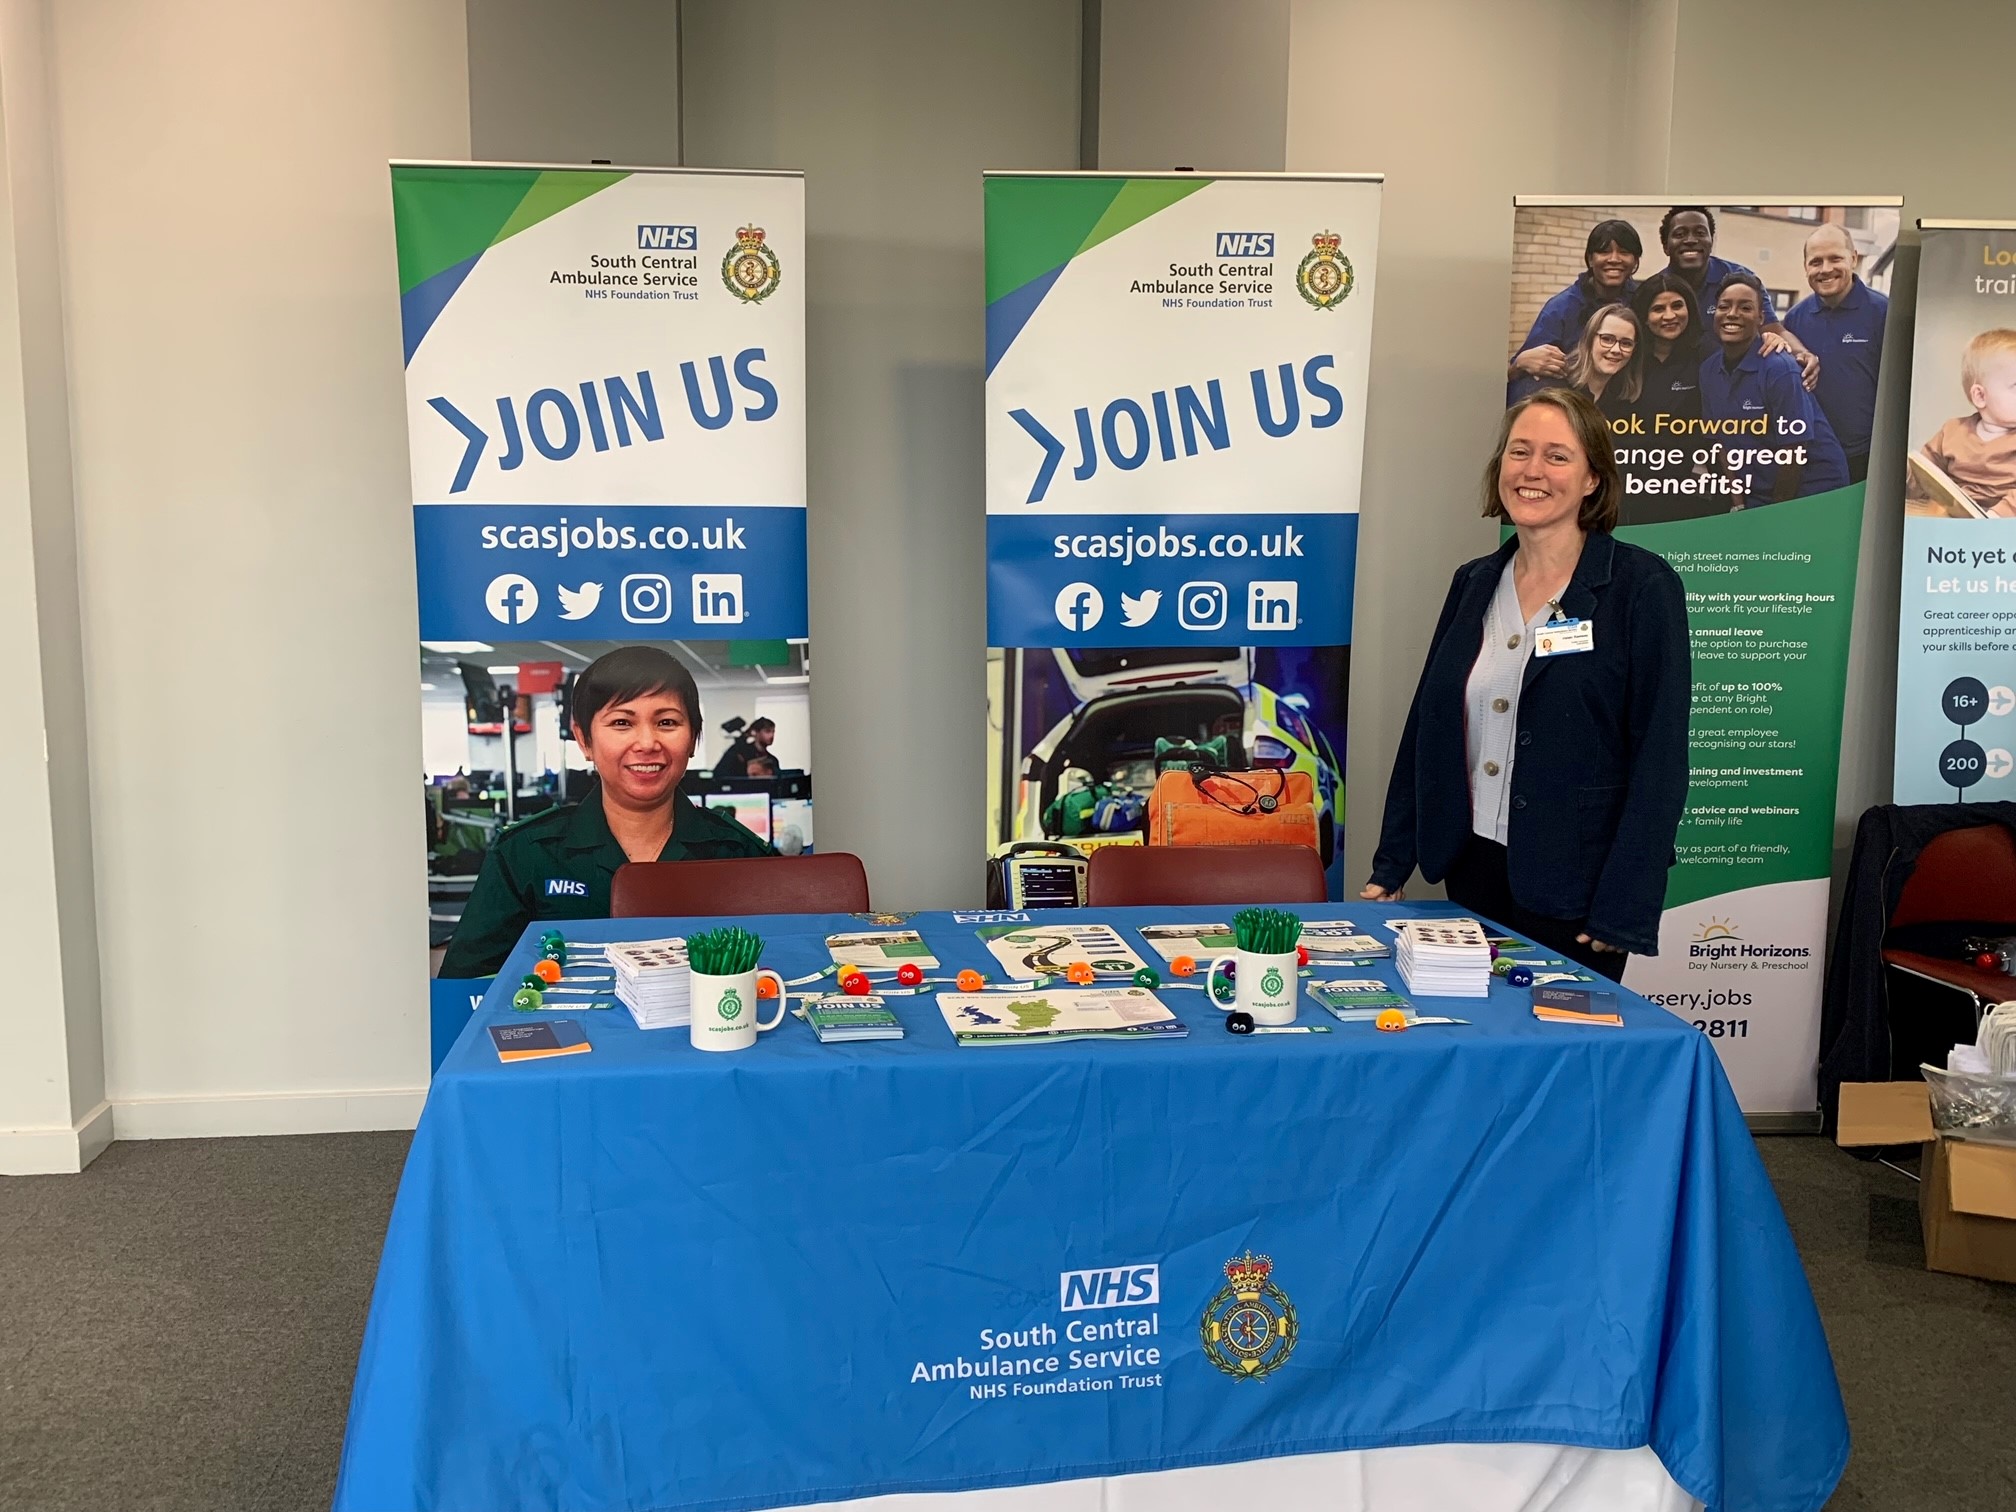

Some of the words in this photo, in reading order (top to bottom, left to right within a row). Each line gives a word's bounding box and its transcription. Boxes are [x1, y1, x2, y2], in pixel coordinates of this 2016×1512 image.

[640, 226, 695, 249] NHS
[1217, 234, 1272, 257] NHS
[591, 255, 636, 269] South
[642, 255, 697, 270] Central
[1169, 263, 1213, 277] South
[1218, 263, 1273, 277] Central
[550, 271, 638, 286] Ambulance
[643, 272, 698, 287] Service
[1975, 275, 2016, 294] trai
[1130, 280, 1214, 294] Ambulance
[1219, 280, 1273, 294] Service
[585, 290, 608, 299] NHS
[611, 290, 670, 300] Foundation
[673, 291, 698, 300] Trust
[1162, 298, 1184, 308] NHS
[1186, 298, 1245, 308] Foundation
[1248, 299, 1273, 308] Trust
[496, 370, 665, 471] JOIN
[680, 348, 779, 431] US
[1073, 378, 1231, 481] JOIN
[1250, 355, 1343, 438] US
[1605, 413, 1645, 434] ok
[1654, 413, 1768, 435] Forward
[1777, 415, 1807, 435] to
[1614, 448, 1684, 471] ange
[1692, 443, 1722, 465] of
[1726, 444, 1807, 471] great
[1625, 473, 1752, 495] benefits!
[481, 518, 747, 557] scasjobs.co.uk
[1054, 526, 1304, 566] scasjobs.co.uk
[1667, 552, 1690, 562] high
[1693, 552, 1723, 561] street
[1725, 553, 1760, 561] names
[1762, 552, 1811, 563] including
[1928, 546, 1966, 564] Not
[1971, 548, 2006, 568] yet
[1673, 564, 1694, 572] and
[1697, 564, 1739, 574] holidays
[1926, 576, 1960, 593] Let
[1966, 580, 1989, 593] us
[1995, 576, 2016, 593] he
[1686, 592, 1706, 603] ility
[1708, 592, 1731, 601] with
[1733, 594, 1757, 604] your
[1759, 592, 1803, 603] working
[1805, 593, 1835, 602] hours
[1706, 605, 1731, 613] work
[1733, 605, 1745, 613] fit
[1746, 606, 1769, 615] your
[1772, 605, 1813, 615] lifestyle
[1924, 610, 1955, 620] Great
[1957, 612, 1990, 620] career
[1695, 628, 1732, 636] annual
[1734, 628, 1764, 636] leave
[1923, 625, 2002, 637] apprenticeship
[1690, 640, 1708, 648] the
[1710, 639, 1743, 649] option
[1745, 640, 1757, 648] to
[1759, 640, 1808, 650] purchase
[1922, 643, 1947, 654] your
[1948, 642, 1972, 651] skills
[1974, 641, 2010, 651] before
[1697, 651, 1725, 659] leave
[1740, 652, 1781, 662] support
[1783, 653, 1807, 662] your
[1691, 682, 1706, 691] efit
[1709, 682, 1721, 691] of
[1721, 684, 1735, 693] up
[1737, 683, 1749, 691] to
[1752, 683, 1783, 691] 100%
[1701, 694, 1712, 702] at
[1714, 695, 1733, 704] any
[1736, 694, 1767, 705] Bright
[1953, 695, 1978, 708] 16+
[1690, 705, 1732, 715] pendent
[1750, 705, 1773, 715] role)
[1698, 728, 1726, 739] great
[1728, 728, 1779, 739] employee
[1689, 739, 1746, 750] recognising
[1768, 740, 1796, 748] stars!
[1947, 757, 1979, 771] 200
[1720, 767, 1741, 775] and
[1743, 767, 1803, 776] investment
[1689, 779, 1749, 788] evelopment
[1691, 806, 1726, 814] advice
[1728, 806, 1749, 814] and
[1751, 806, 1800, 815] webinars
[1695, 816, 1726, 827] family
[1728, 816, 1743, 825] life
[1704, 845, 1726, 855] part
[1728, 844, 1739, 853] of
[1750, 844, 1790, 855] friendly,
[1680, 855, 1734, 866] welcoming
[1737, 856, 1764, 864] team
[548, 880, 586, 895] NHS
[1690, 944, 1736, 960] Bright
[1689, 962, 1707, 970] Day
[1710, 962, 1748, 970] Nursery
[1750, 962, 1759, 970] &
[1762, 961, 1809, 970] Preschool
[1064, 1267, 1154, 1307] NHS
[980, 1323, 1056, 1350] South
[1066, 1313, 1158, 1343] Central
[911, 1354, 1059, 1383] Ambulance
[1069, 1346, 1161, 1369] Service
[970, 1384, 1007, 1400] NHS
[1013, 1375, 1113, 1396] Foundation
[1119, 1373, 1162, 1389] Trust
